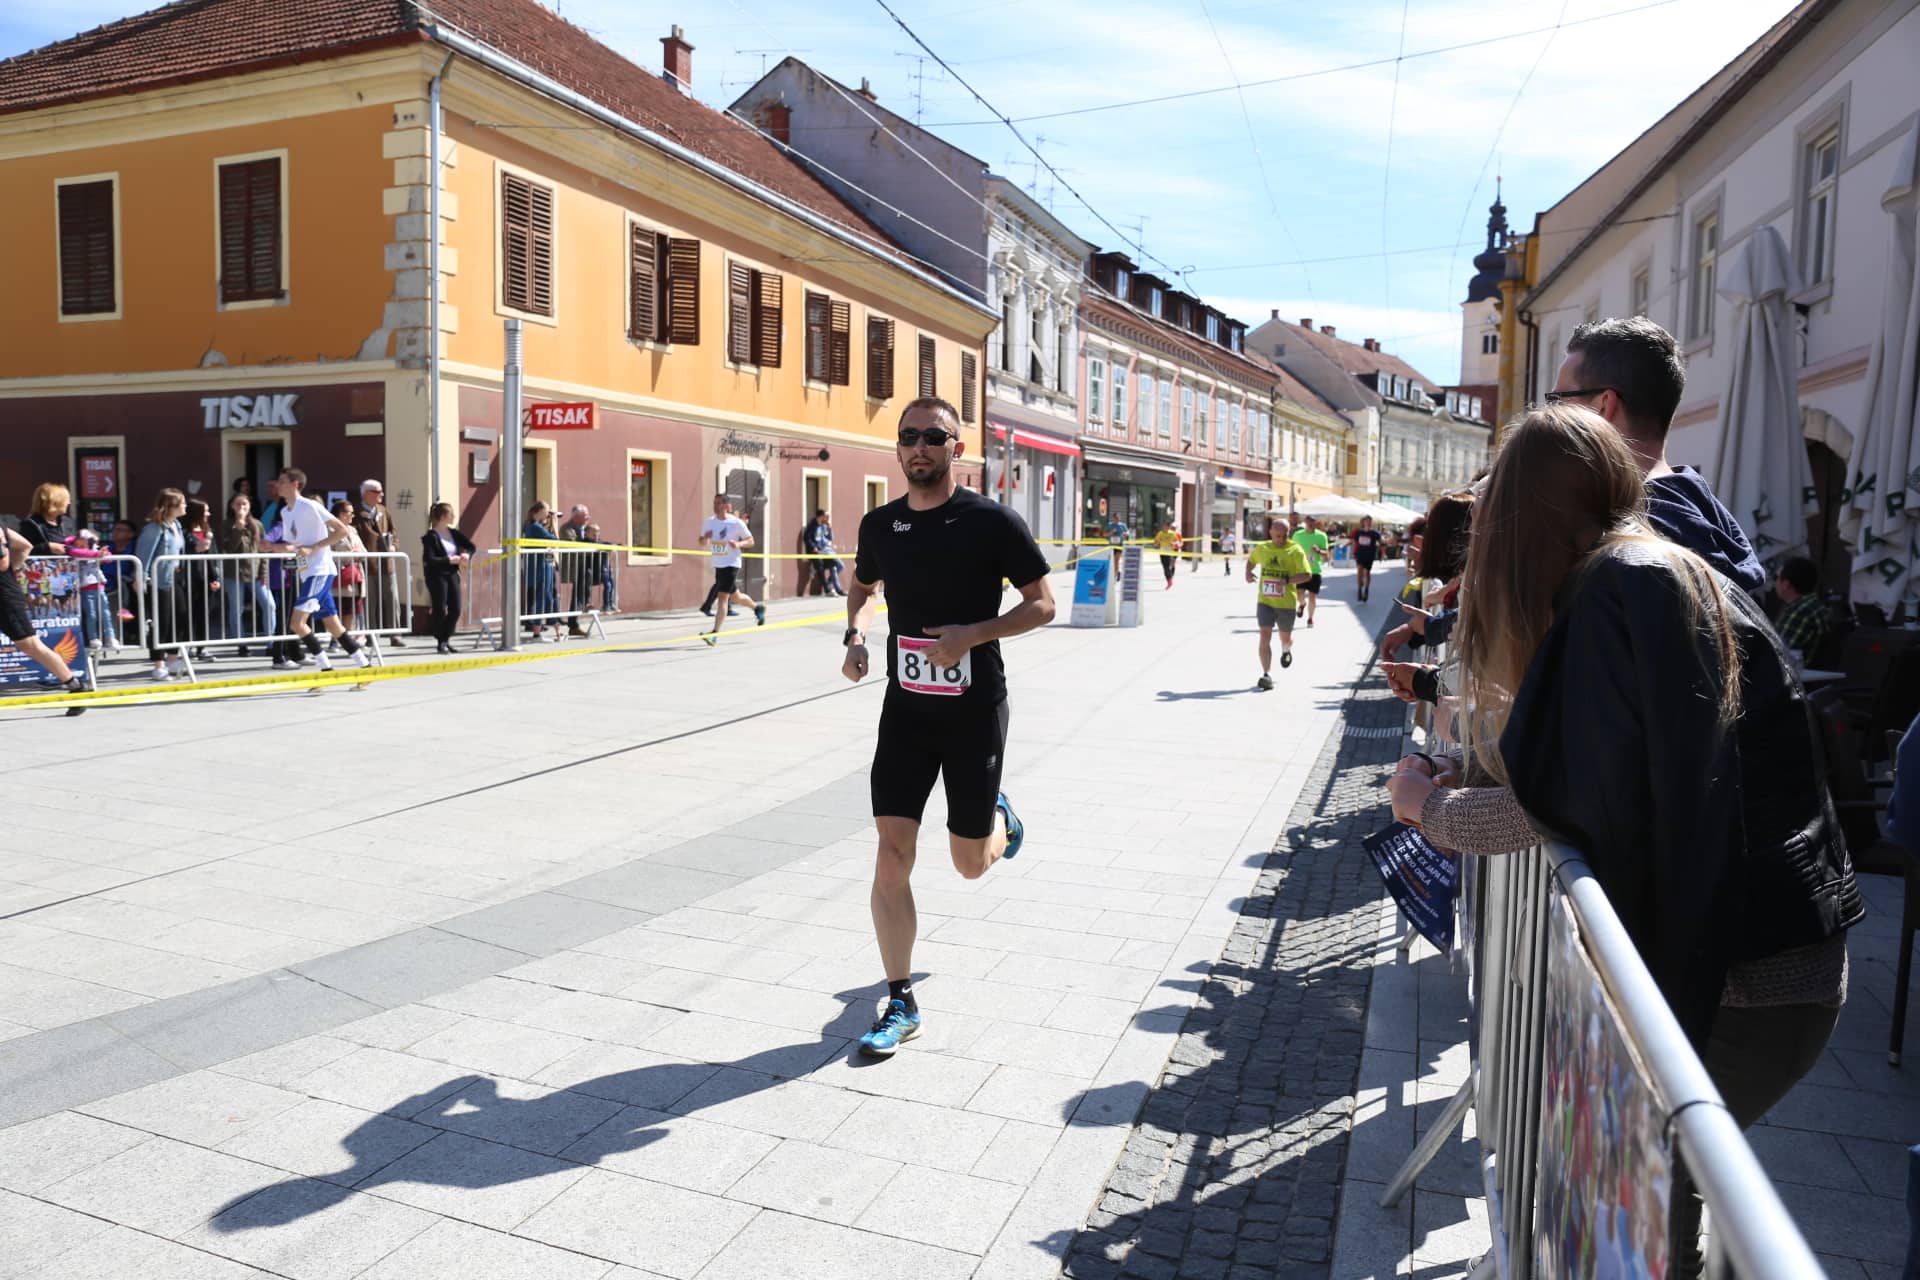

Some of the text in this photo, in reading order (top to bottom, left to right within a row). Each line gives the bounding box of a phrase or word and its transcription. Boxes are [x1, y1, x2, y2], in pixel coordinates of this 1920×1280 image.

[201, 394, 299, 429] TISAK
[535, 407, 590, 426] TISAK
[85, 460, 113, 470] TISAK
[31, 617, 80, 629] araton
